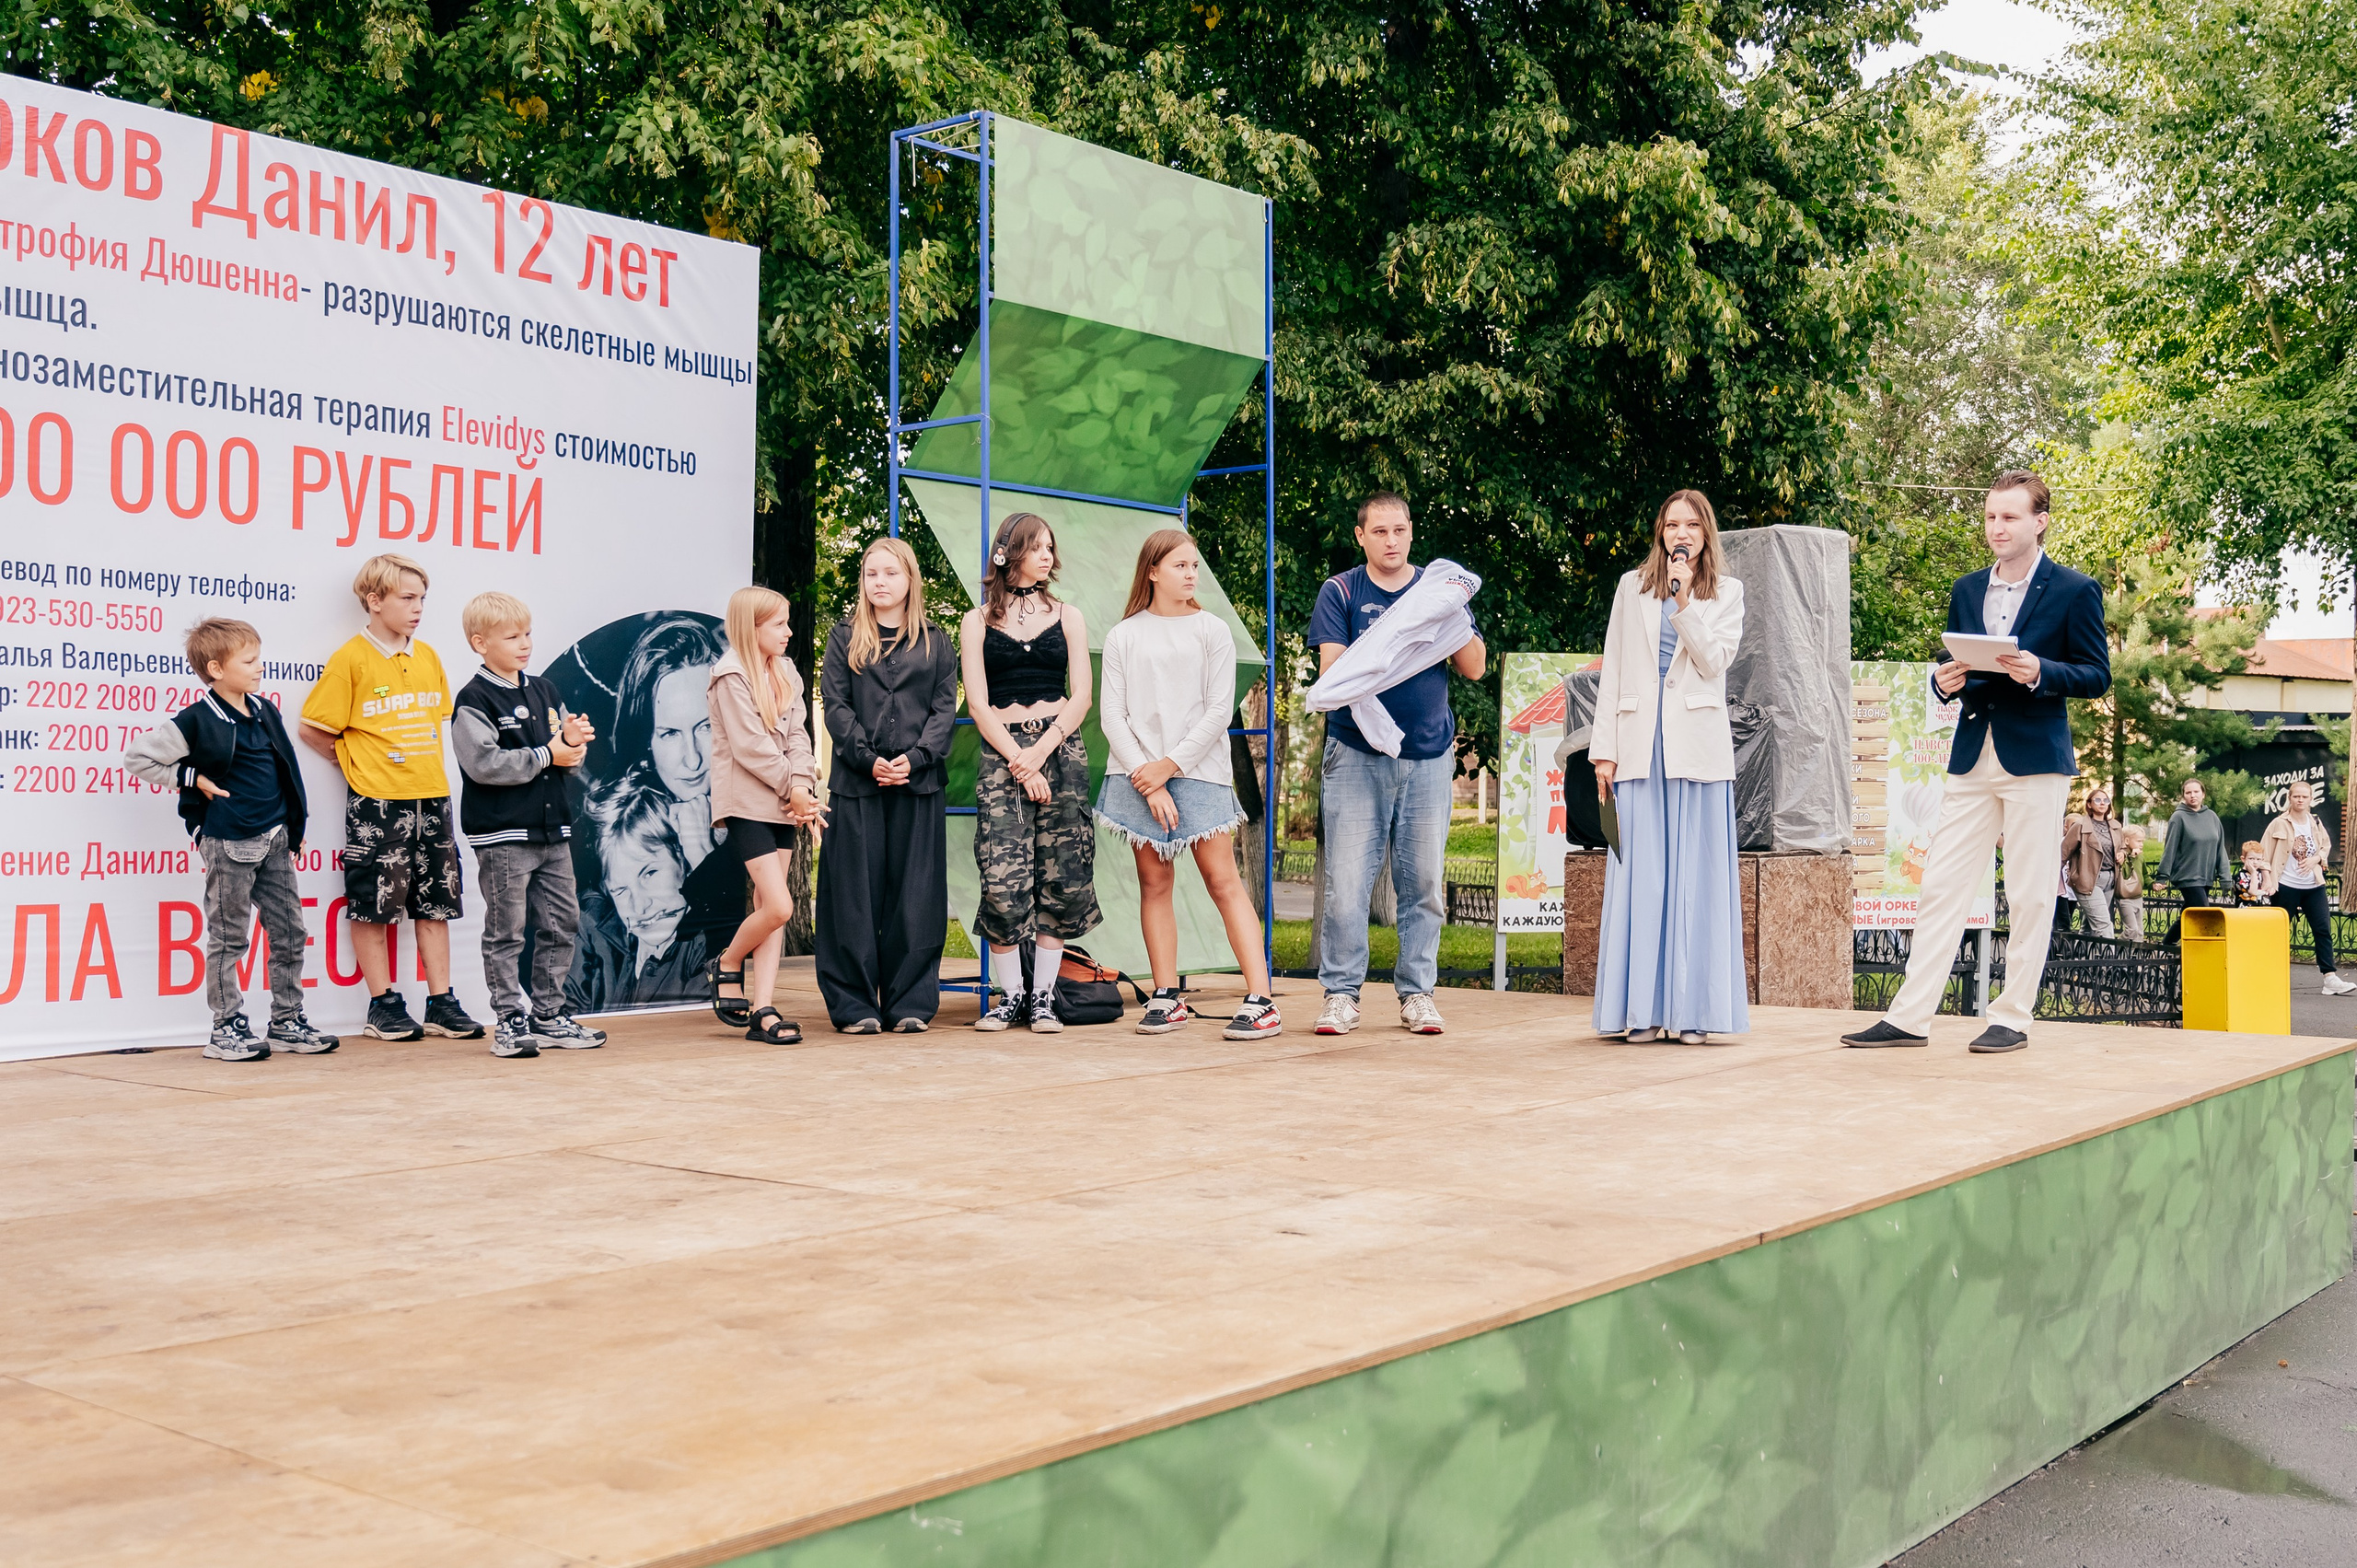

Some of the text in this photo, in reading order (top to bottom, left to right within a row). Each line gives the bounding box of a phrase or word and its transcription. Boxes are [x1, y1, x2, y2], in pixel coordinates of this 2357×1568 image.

[192, 122, 456, 276] Данил,
[482, 189, 553, 284] 12
[577, 233, 679, 308] лет
[0, 219, 752, 387] трофия Дюшенна- разрушаются скелетные мышцы
[313, 395, 430, 439] терапия
[442, 405, 545, 458] Elevidys
[554, 432, 697, 476] стоимостью
[110, 423, 260, 525] 000
[292, 445, 543, 555] РУБЛЕЙ
[1, 559, 296, 604] евод по номеру телефона:
[62, 642, 196, 677] Валерьевна
[26, 680, 88, 709] 2202
[97, 683, 157, 713] 2080
[0, 729, 39, 750] нк:
[47, 724, 110, 751] 2200
[13, 765, 142, 794] 2200 2414
[2263, 765, 2324, 788] ЗАХОДИ ЗА
[2264, 781, 2326, 815] КОЕ
[1, 850, 70, 876] ение
[1503, 916, 1563, 926] КАЖДУЮ
[0, 902, 122, 1005] ЛА
